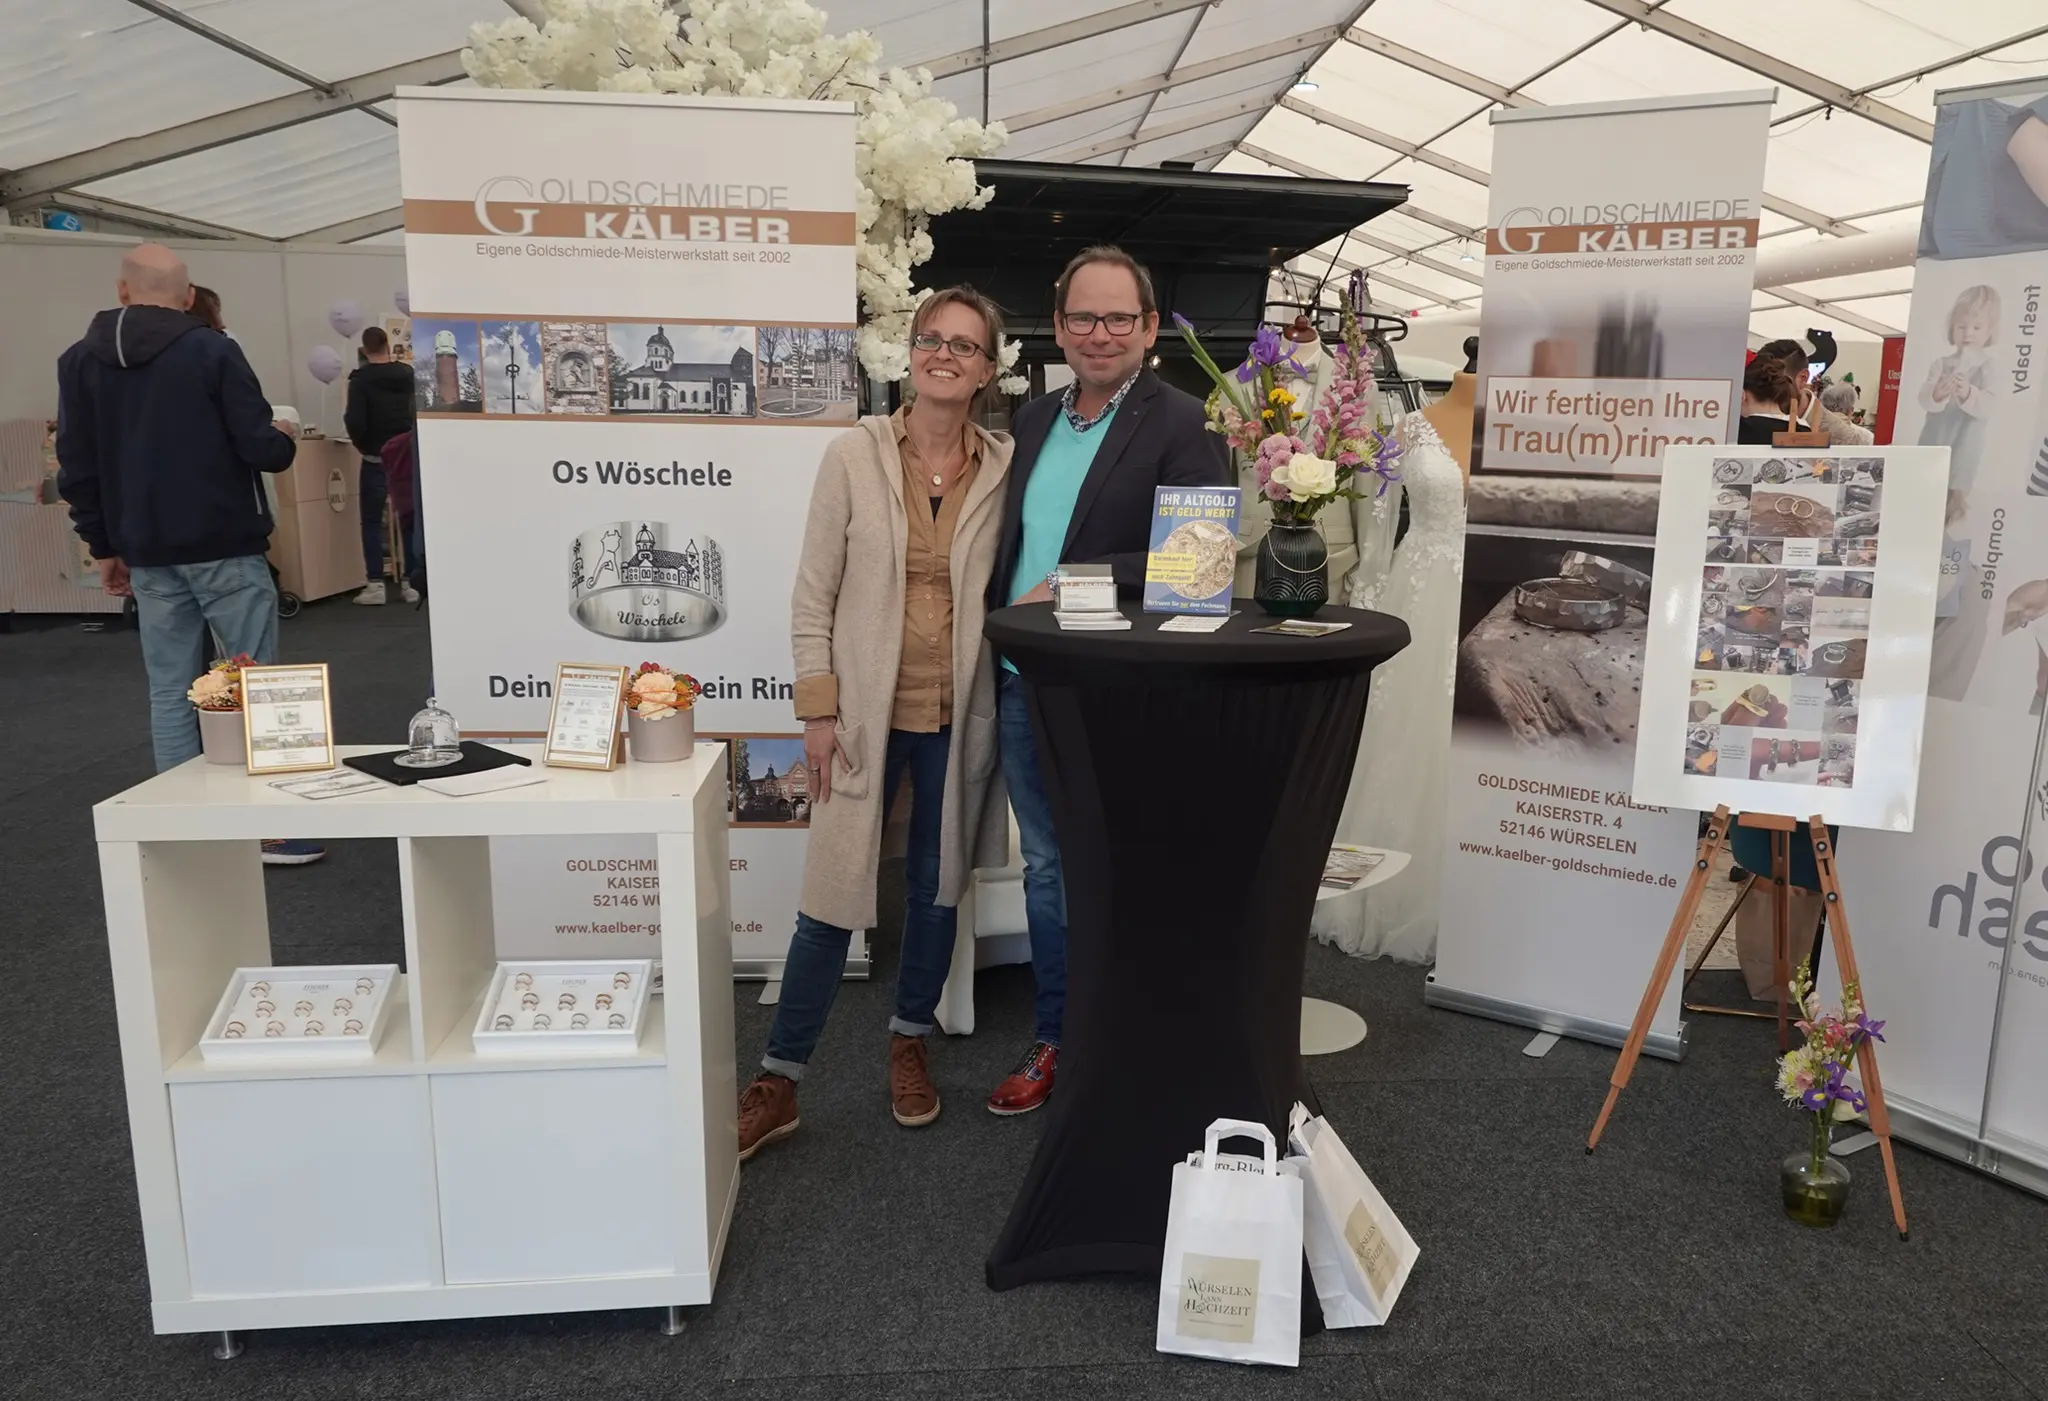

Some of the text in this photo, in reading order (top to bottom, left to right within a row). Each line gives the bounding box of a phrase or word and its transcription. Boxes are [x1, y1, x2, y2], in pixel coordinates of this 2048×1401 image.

[475, 176, 789, 237] GOLDSCHMIEDE
[584, 206, 790, 244] KÄLBER
[1498, 199, 1750, 255] GOLDSCHMIEDE
[1578, 223, 1748, 253] KÄLBER
[476, 242, 791, 264] Eigene Goldschmiede-Meisterwerkstatt seit 2002
[1495, 254, 1745, 272] Eigene Goldschmiede-Meisterwerkstatt seit 2002
[1496, 389, 1720, 422] Wir fertigen Ihre
[552, 460, 733, 487] Os Wöschele
[1158, 506, 1235, 519] IST GELD WERT!
[1160, 492, 1237, 507] IHR ALTGOLD
[617, 610, 687, 627] Wöschele
[489, 674, 553, 700] Dein
[702, 676, 742, 700] ein
[752, 677, 794, 701] Rin
[1477, 772, 1601, 805] GOLDSCHMIEDE
[1515, 800, 1623, 830] KAISERSTR. 4
[1499, 819, 1637, 855] 52146 WÜRSELEN
[566, 858, 658, 872] GOLDSCHMI
[1459, 840, 1678, 889] www.kaelber-goldschmiede.de
[607, 876, 660, 889] KAISER
[593, 894, 639, 907] 52146
[1187, 1276, 1252, 1297] WÜRSELEN
[1184, 1299, 1251, 1317] HOCHZEIT
